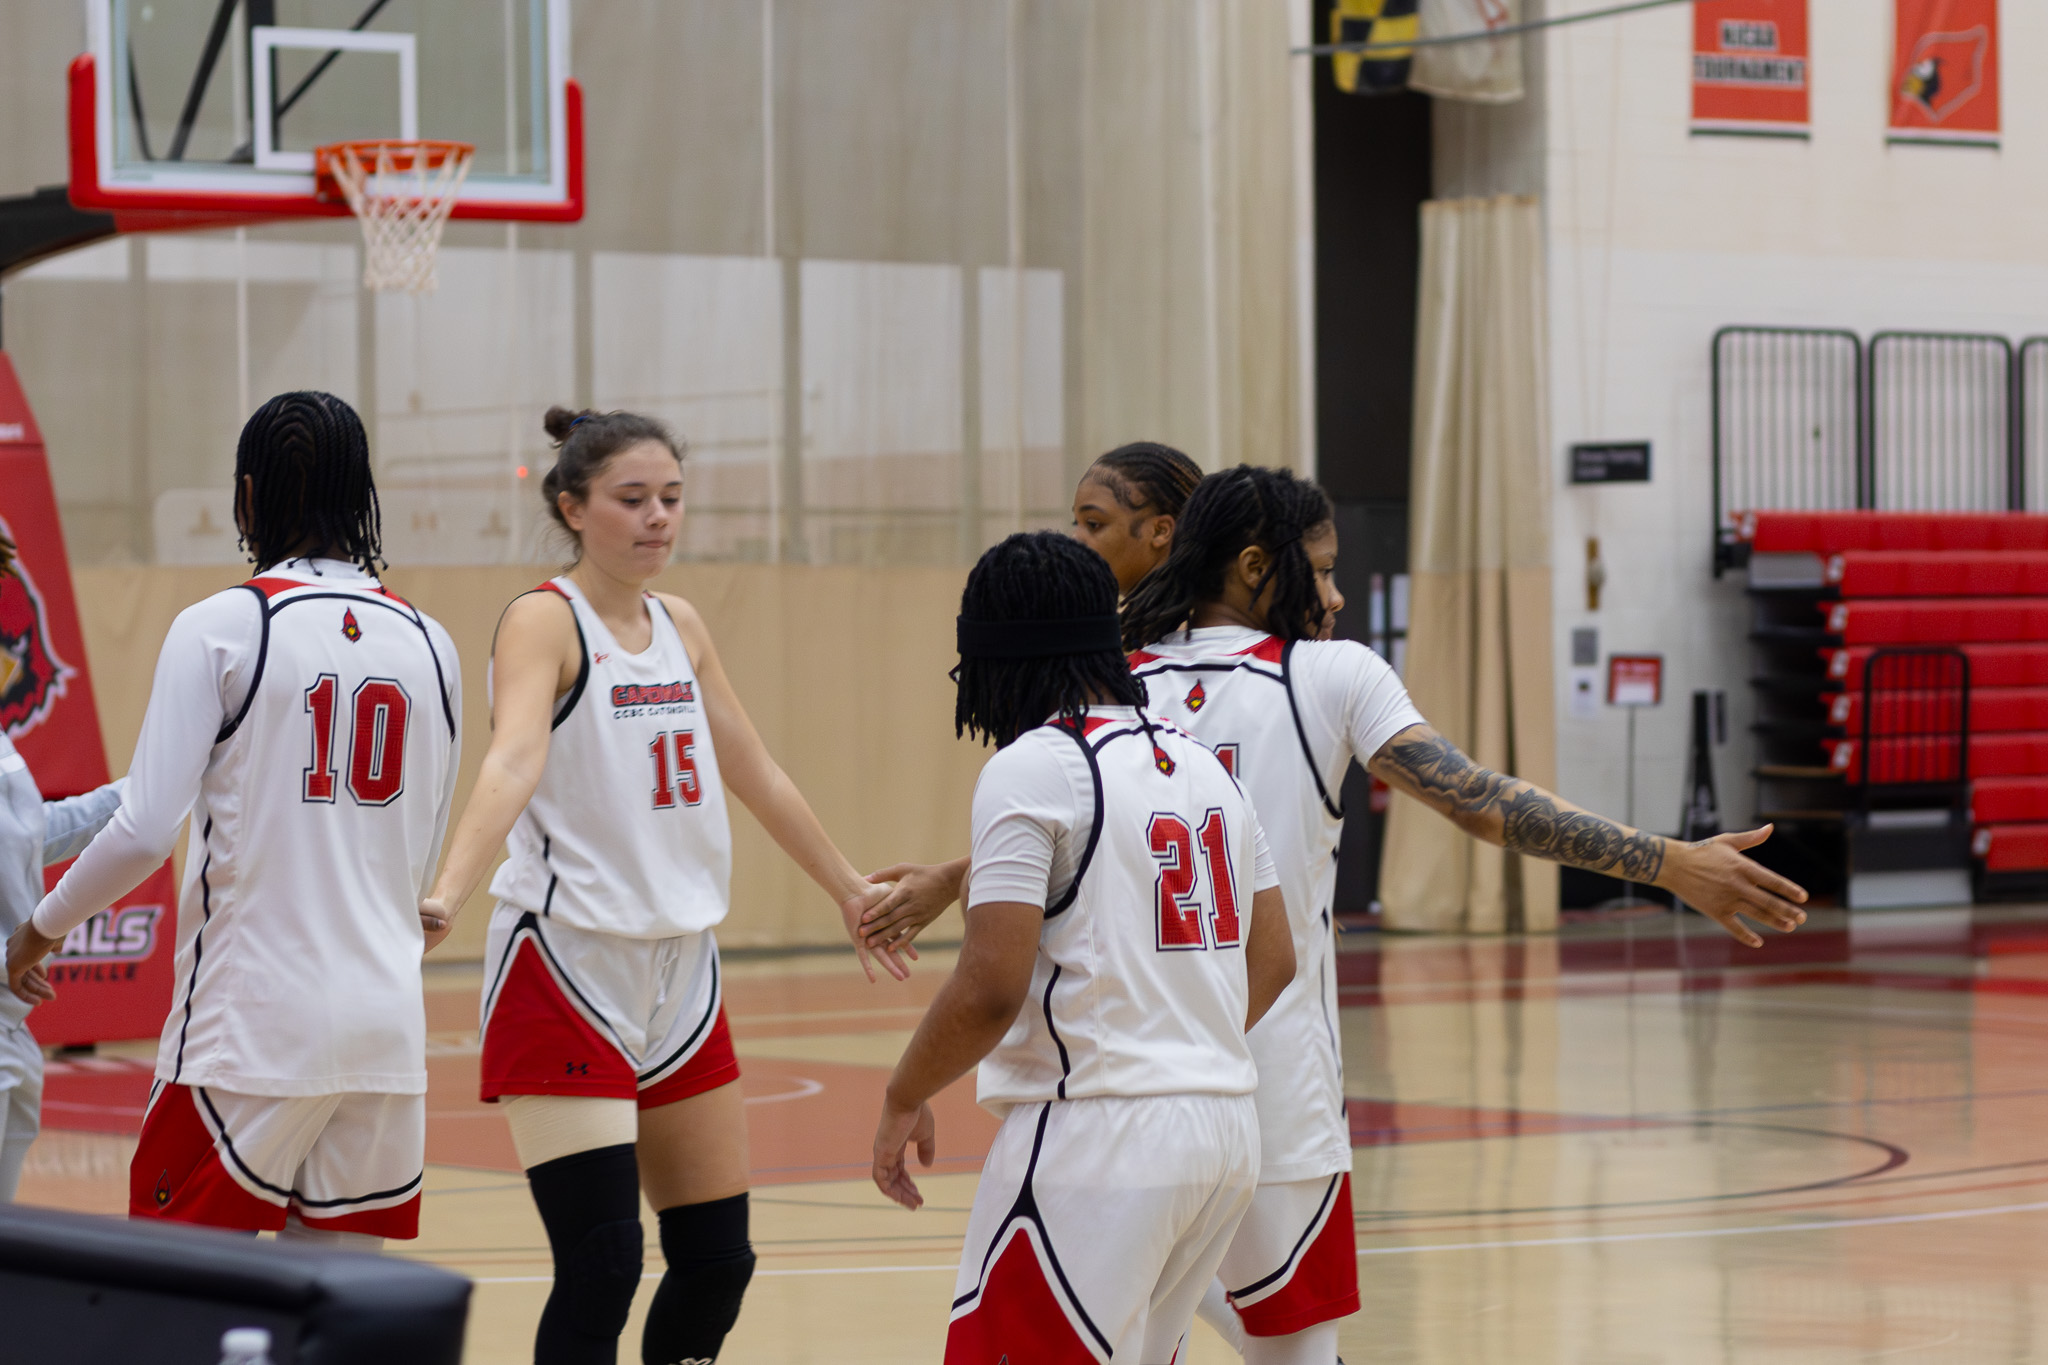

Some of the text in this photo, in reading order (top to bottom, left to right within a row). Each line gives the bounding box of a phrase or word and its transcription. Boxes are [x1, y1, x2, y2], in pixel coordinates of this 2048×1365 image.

[1693, 55, 1805, 84] TOURNAMENT
[614, 708, 645, 720] CCBC
[302, 673, 412, 807] 10
[648, 729, 704, 810] 15
[1146, 807, 1240, 952] 21
[60, 907, 162, 957] ALS
[52, 963, 139, 984] SVILLE
